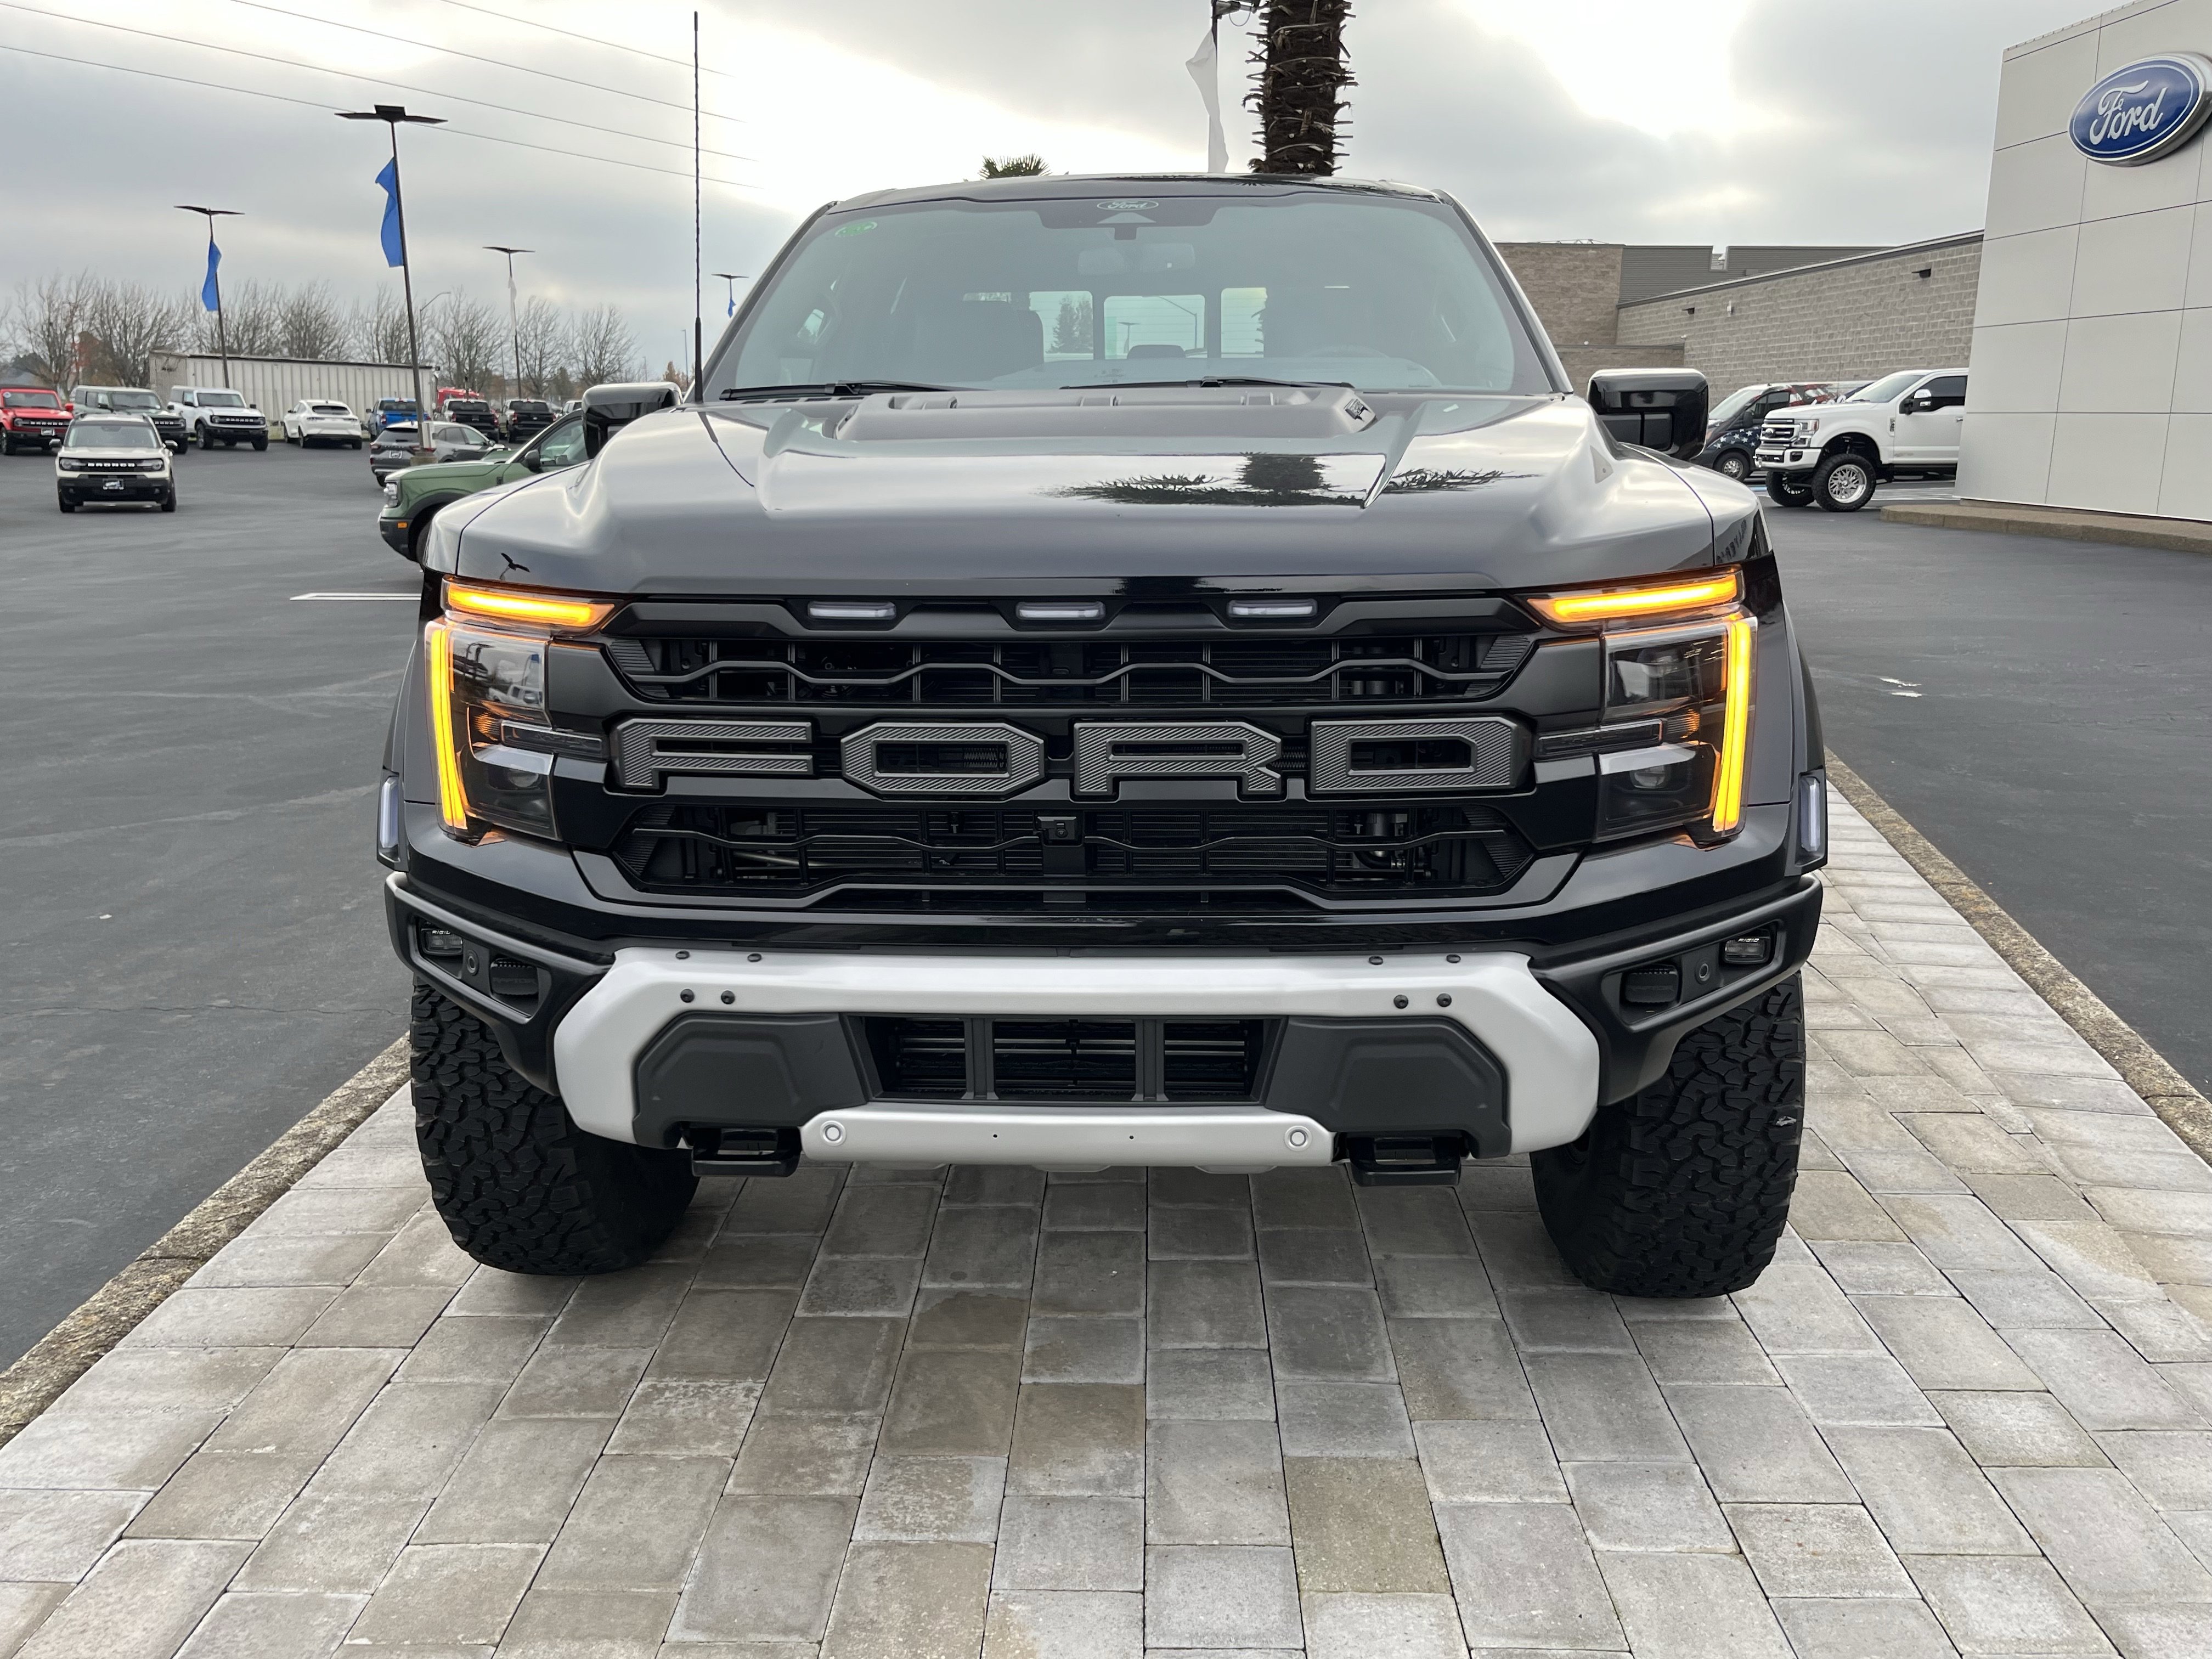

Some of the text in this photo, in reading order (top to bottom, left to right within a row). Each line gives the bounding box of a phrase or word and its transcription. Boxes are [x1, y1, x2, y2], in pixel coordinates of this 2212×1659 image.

[2089, 80, 2168, 145] Ford
[1108, 201, 1148, 209] Ford
[613, 716, 1528, 797] FORD
